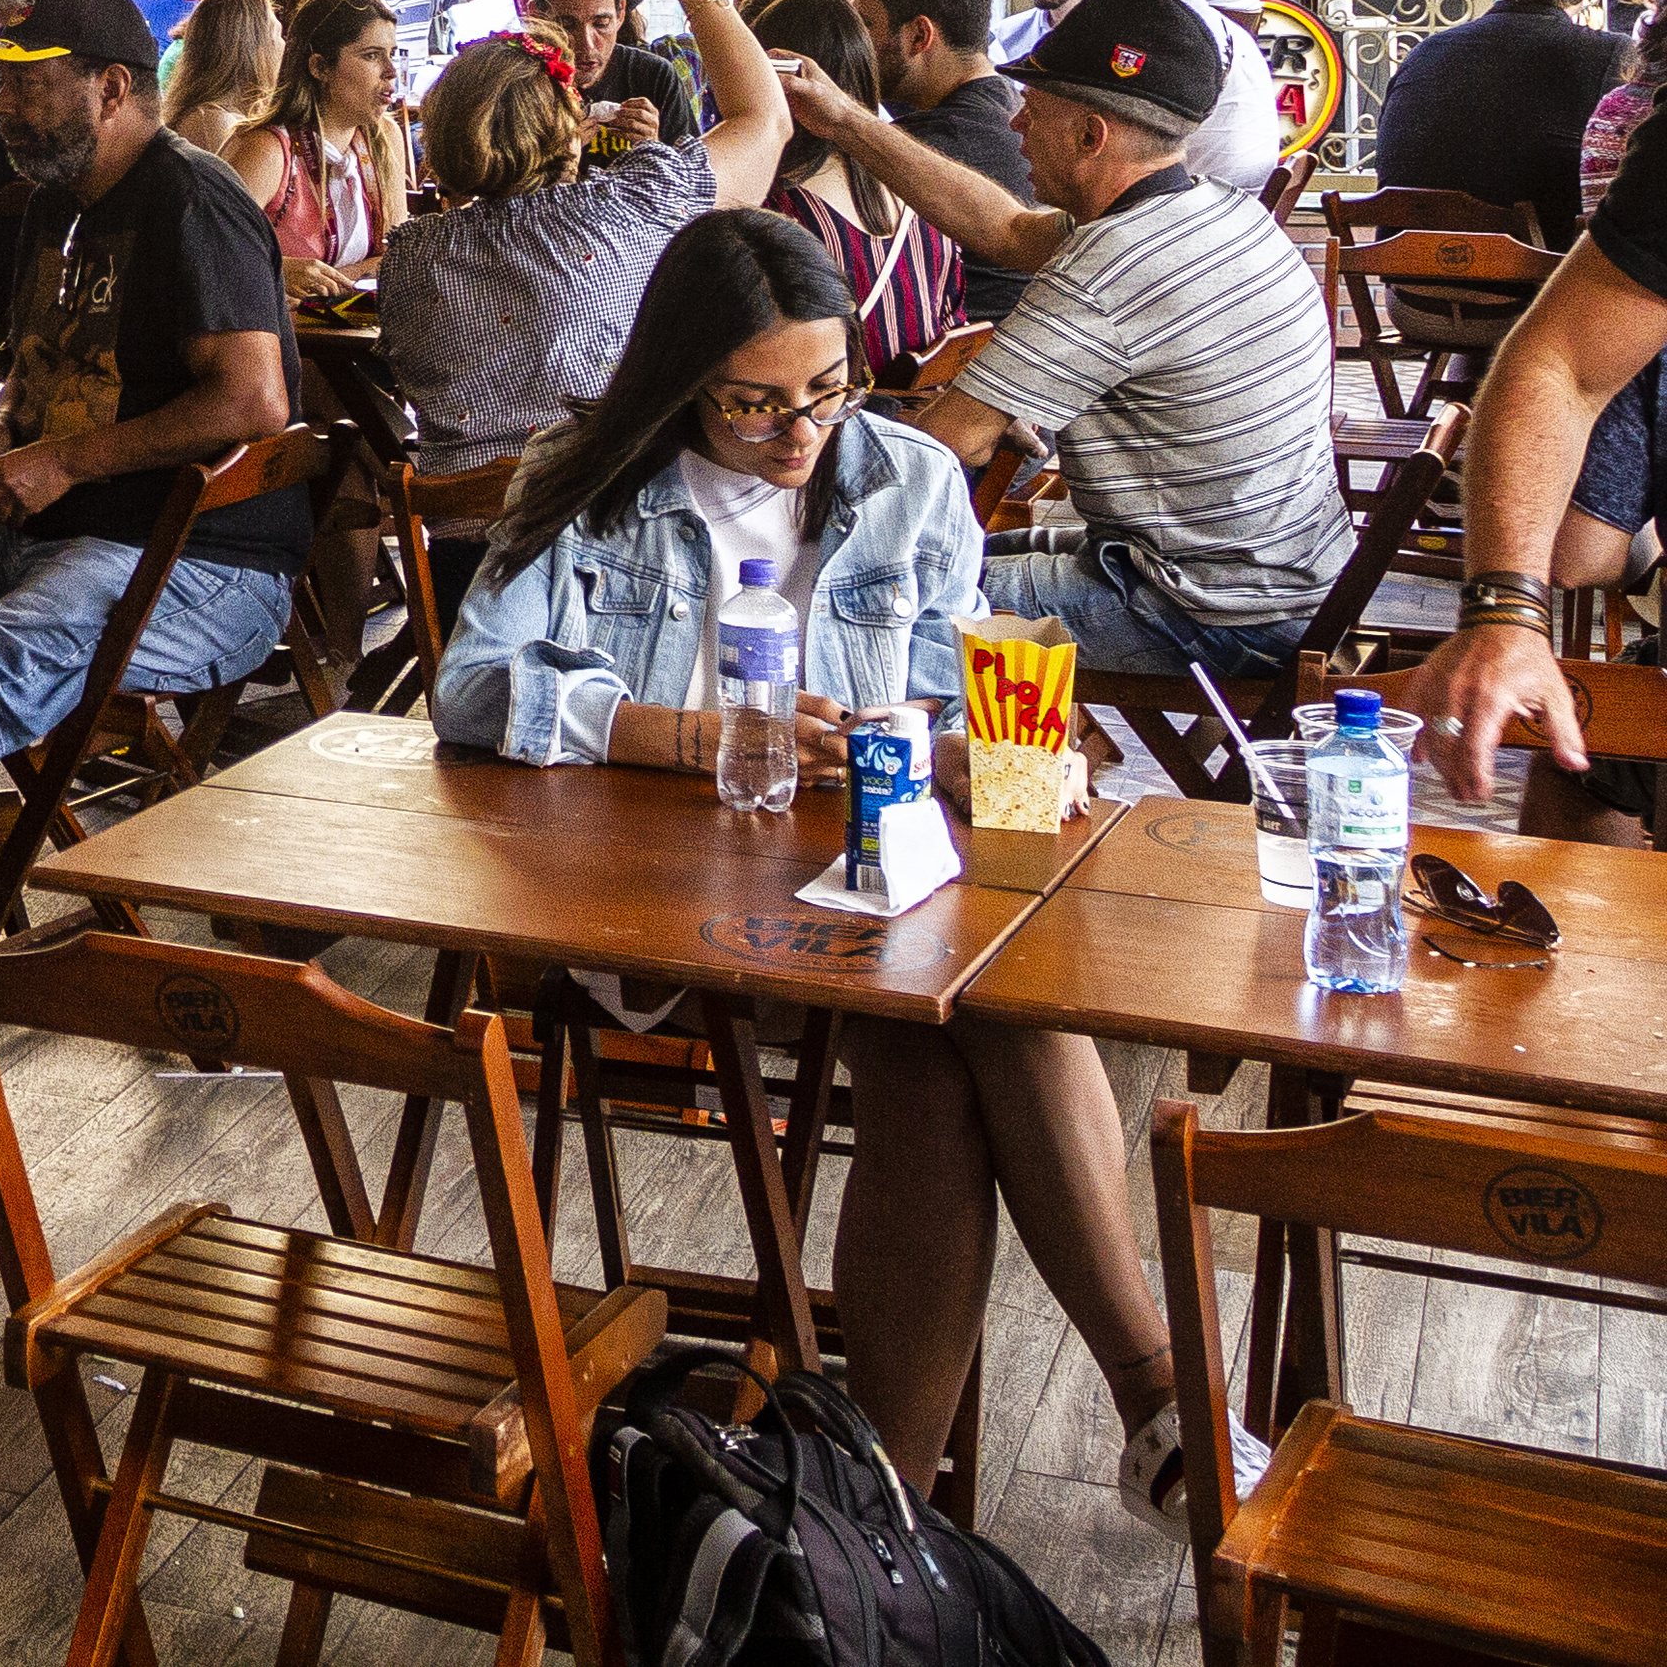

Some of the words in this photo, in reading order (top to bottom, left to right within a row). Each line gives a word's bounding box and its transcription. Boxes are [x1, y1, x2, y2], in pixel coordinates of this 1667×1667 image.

[972, 648, 1006, 677] PI
[994, 675, 1042, 706] PO
[1018, 705, 1066, 735] CA
[1498, 1187, 1579, 1208] BIER
[1507, 1213, 1586, 1240] VILA
